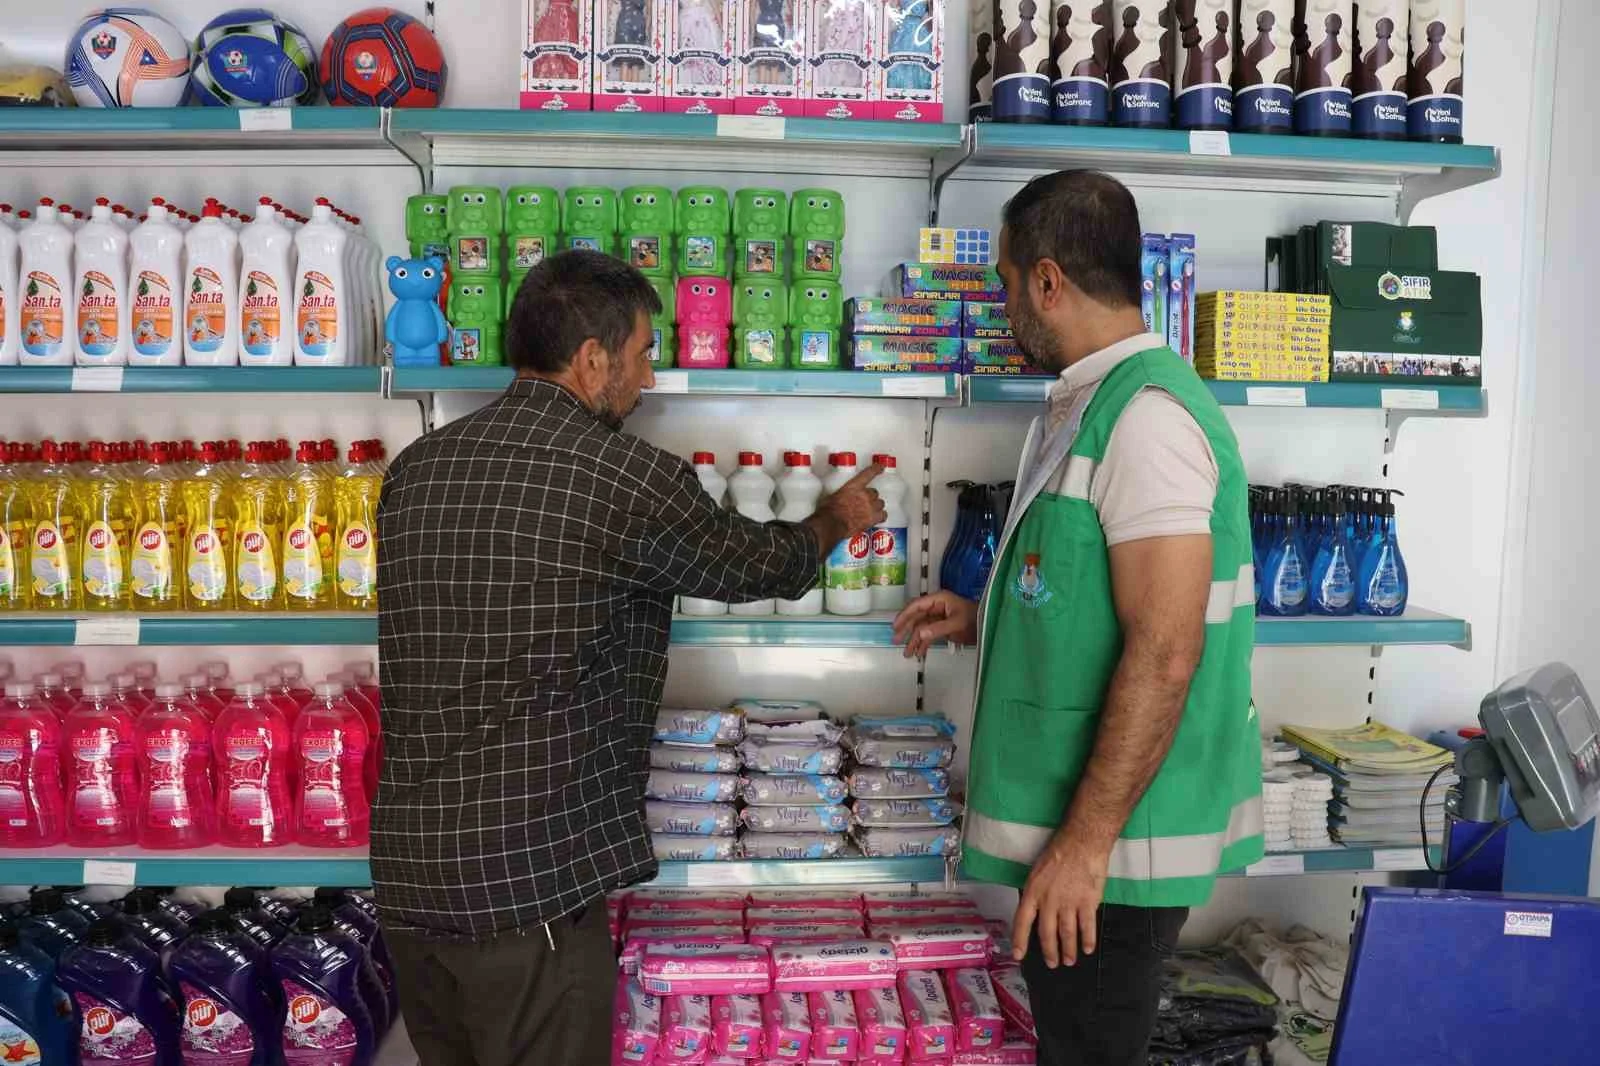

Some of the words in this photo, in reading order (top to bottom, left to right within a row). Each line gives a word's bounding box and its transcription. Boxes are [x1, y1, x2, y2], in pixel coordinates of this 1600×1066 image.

[932, 270, 984, 280] MAGIC
[1403, 277, 1429, 287] SIFIR
[883, 303, 936, 315] MAGIC
[974, 328, 1013, 336] SINIRLA
[883, 342, 937, 353] MAGIC
[142, 531, 159, 547] pür
[349, 531, 365, 547] pür
[191, 1003, 212, 1022] pür
[295, 1000, 316, 1020] pür
[91, 1011, 110, 1031] pür
